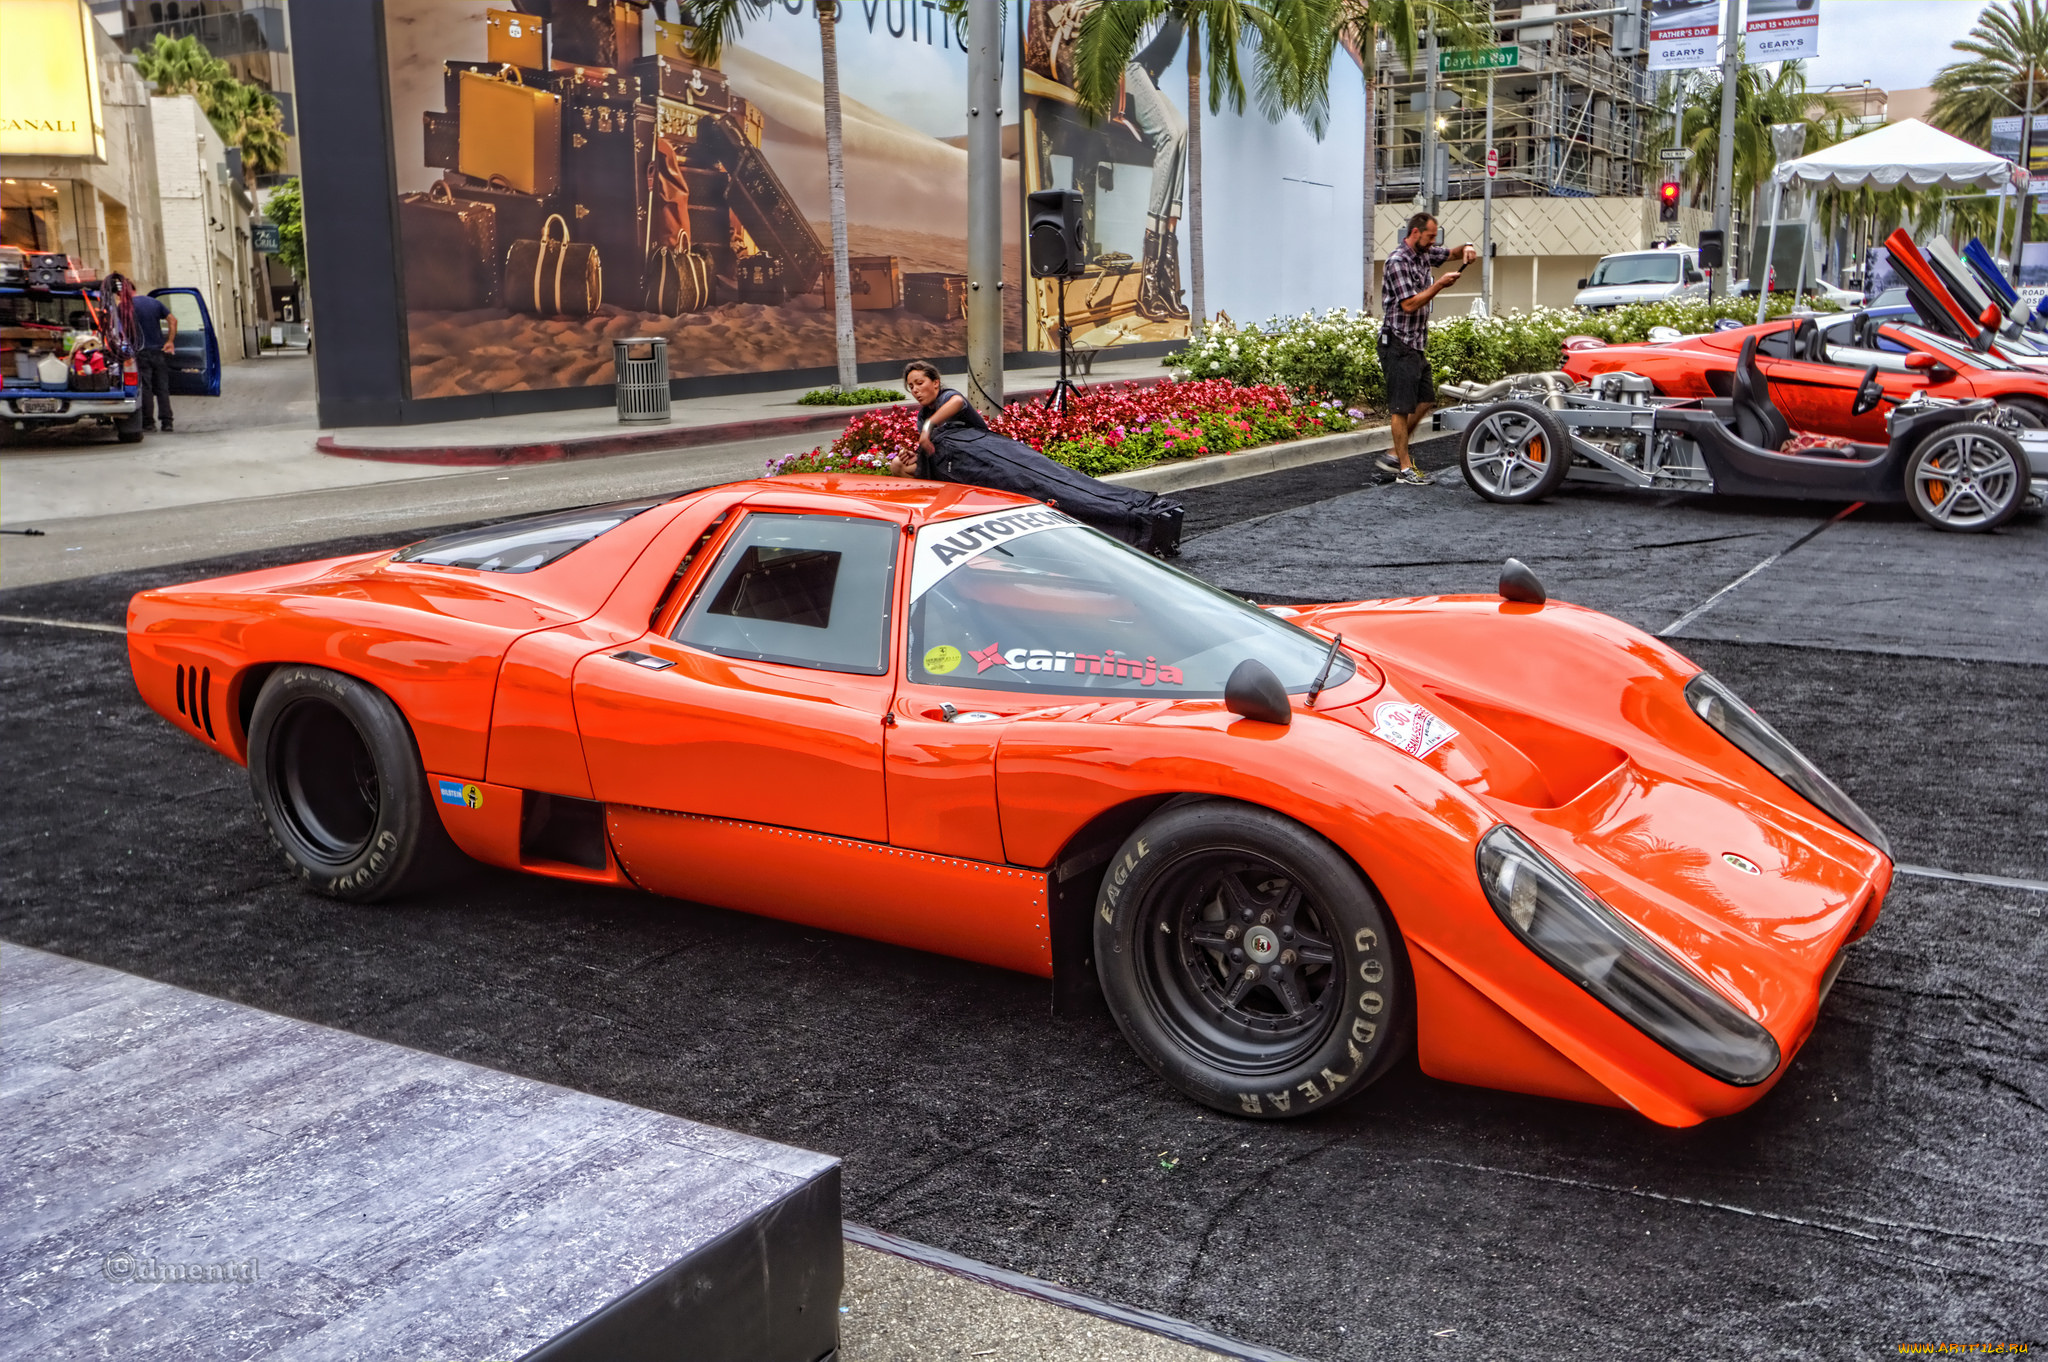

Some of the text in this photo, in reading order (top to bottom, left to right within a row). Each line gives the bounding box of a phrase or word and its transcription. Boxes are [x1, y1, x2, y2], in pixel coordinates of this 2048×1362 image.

[1748, 22, 1767, 31] JUNE
[1769, 21, 1777, 29] 15
[1783, 18, 1817, 27] 10AM-4PM
[1658, 28, 1710, 39] FATHER'S DAY
[1759, 38, 1804, 49] GEARYS
[1662, 47, 1704, 58] GEARYS
[1444, 52, 1513, 69] Dayton Way
[1003, 648, 1183, 686] carninja
[1388, 711, 1410, 726] 30
[1100, 837, 1150, 925] EAGLE
